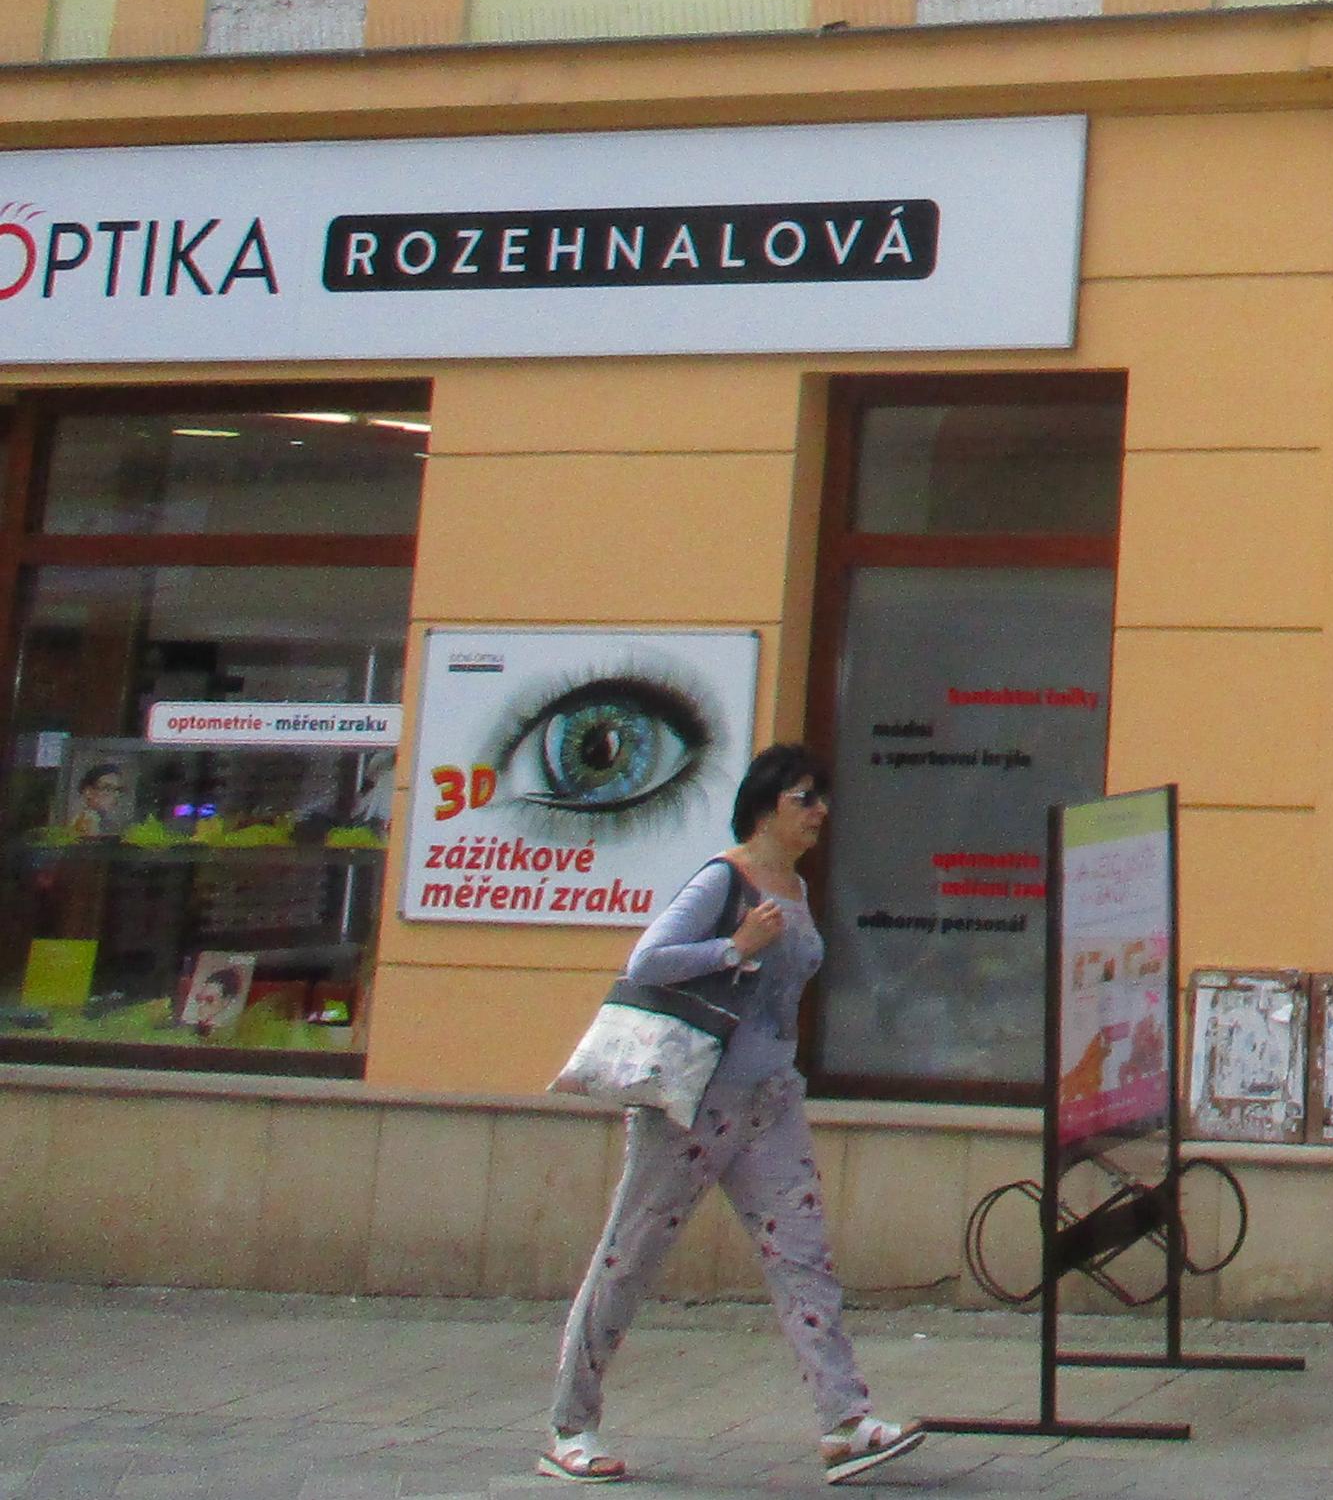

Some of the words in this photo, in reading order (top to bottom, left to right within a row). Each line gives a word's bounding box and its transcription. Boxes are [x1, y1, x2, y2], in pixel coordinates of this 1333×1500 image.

[344, 204, 913, 277] ROZEHNALOVÁ
[167, 713, 262, 732] optometrie
[275, 714, 335, 732] měření
[337, 714, 387, 732] zraku
[431, 763, 498, 821] 3D
[425, 836, 595, 873] zážitkové
[420, 876, 548, 911] měření
[549, 878, 654, 914] zraku
